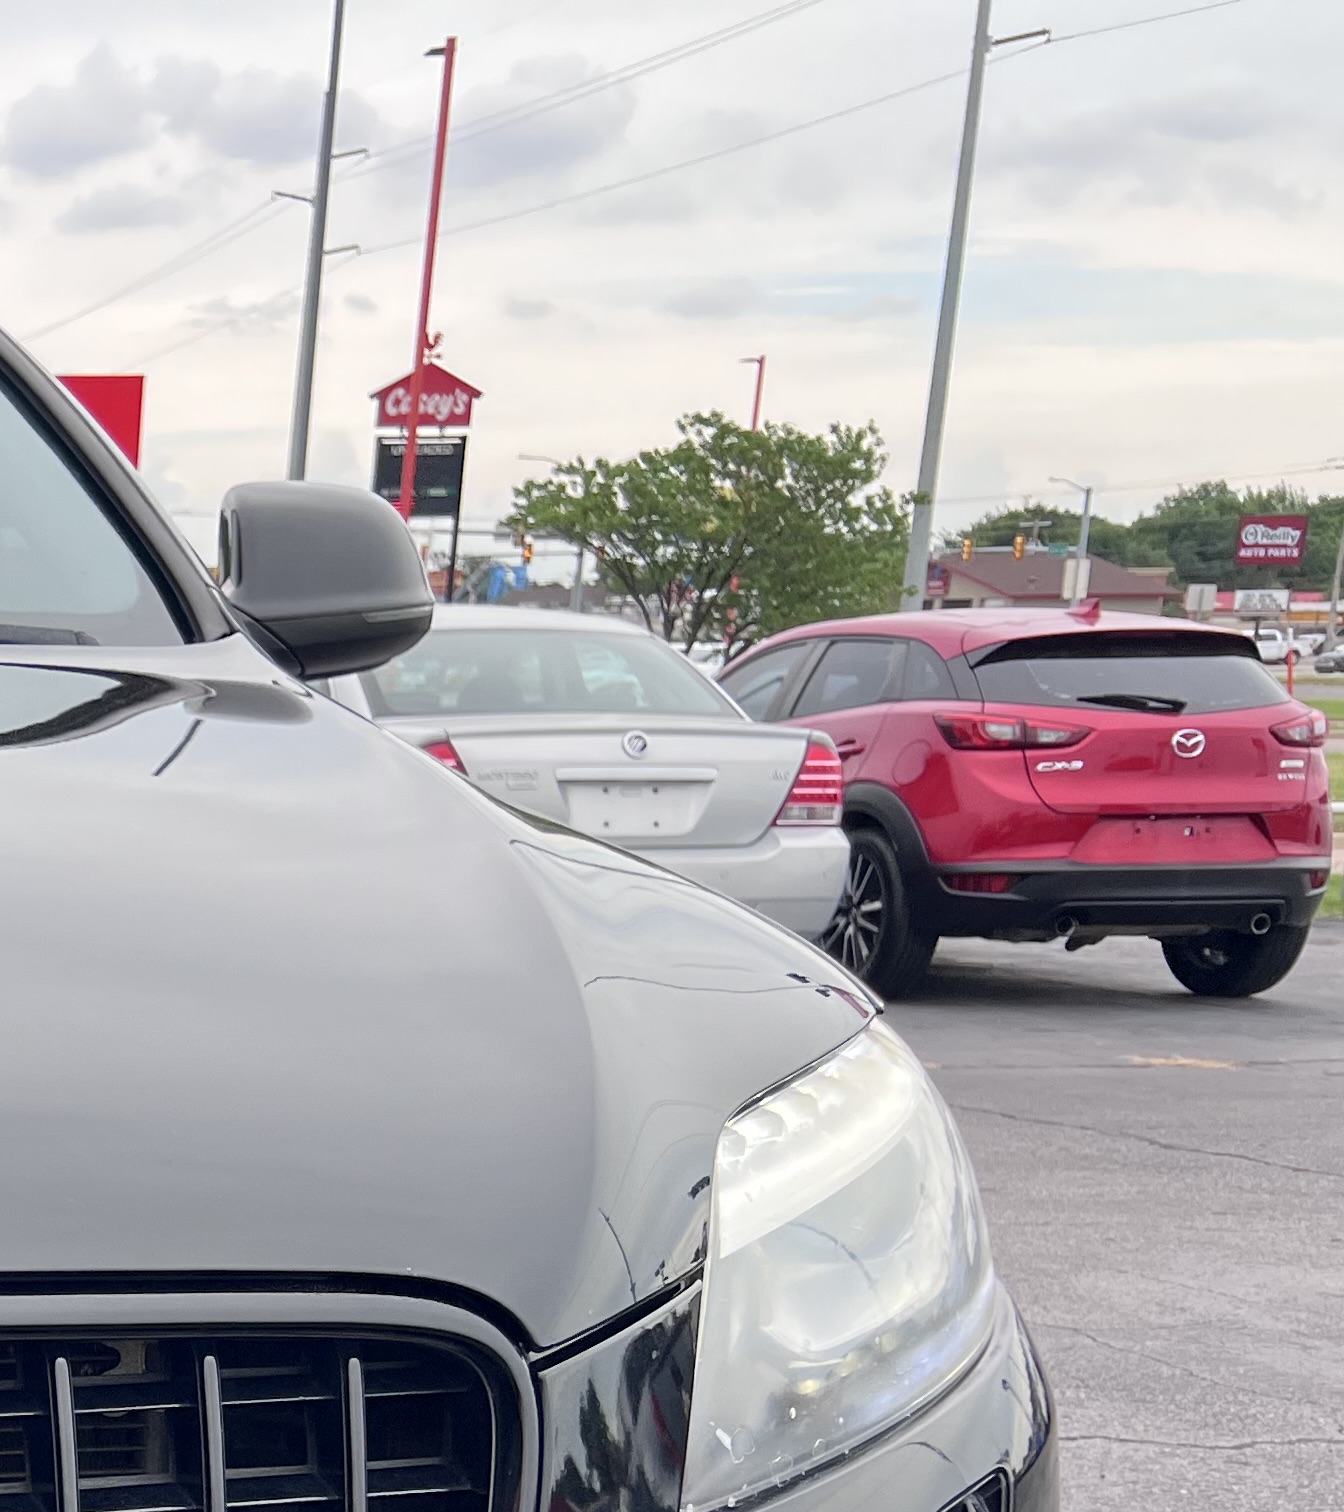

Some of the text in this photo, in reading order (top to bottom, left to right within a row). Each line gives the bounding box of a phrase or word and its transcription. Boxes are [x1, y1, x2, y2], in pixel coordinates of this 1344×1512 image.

[1242, 524, 1301, 547] O'Reilly
[1239, 547, 1299, 558] AUTO PARTS
